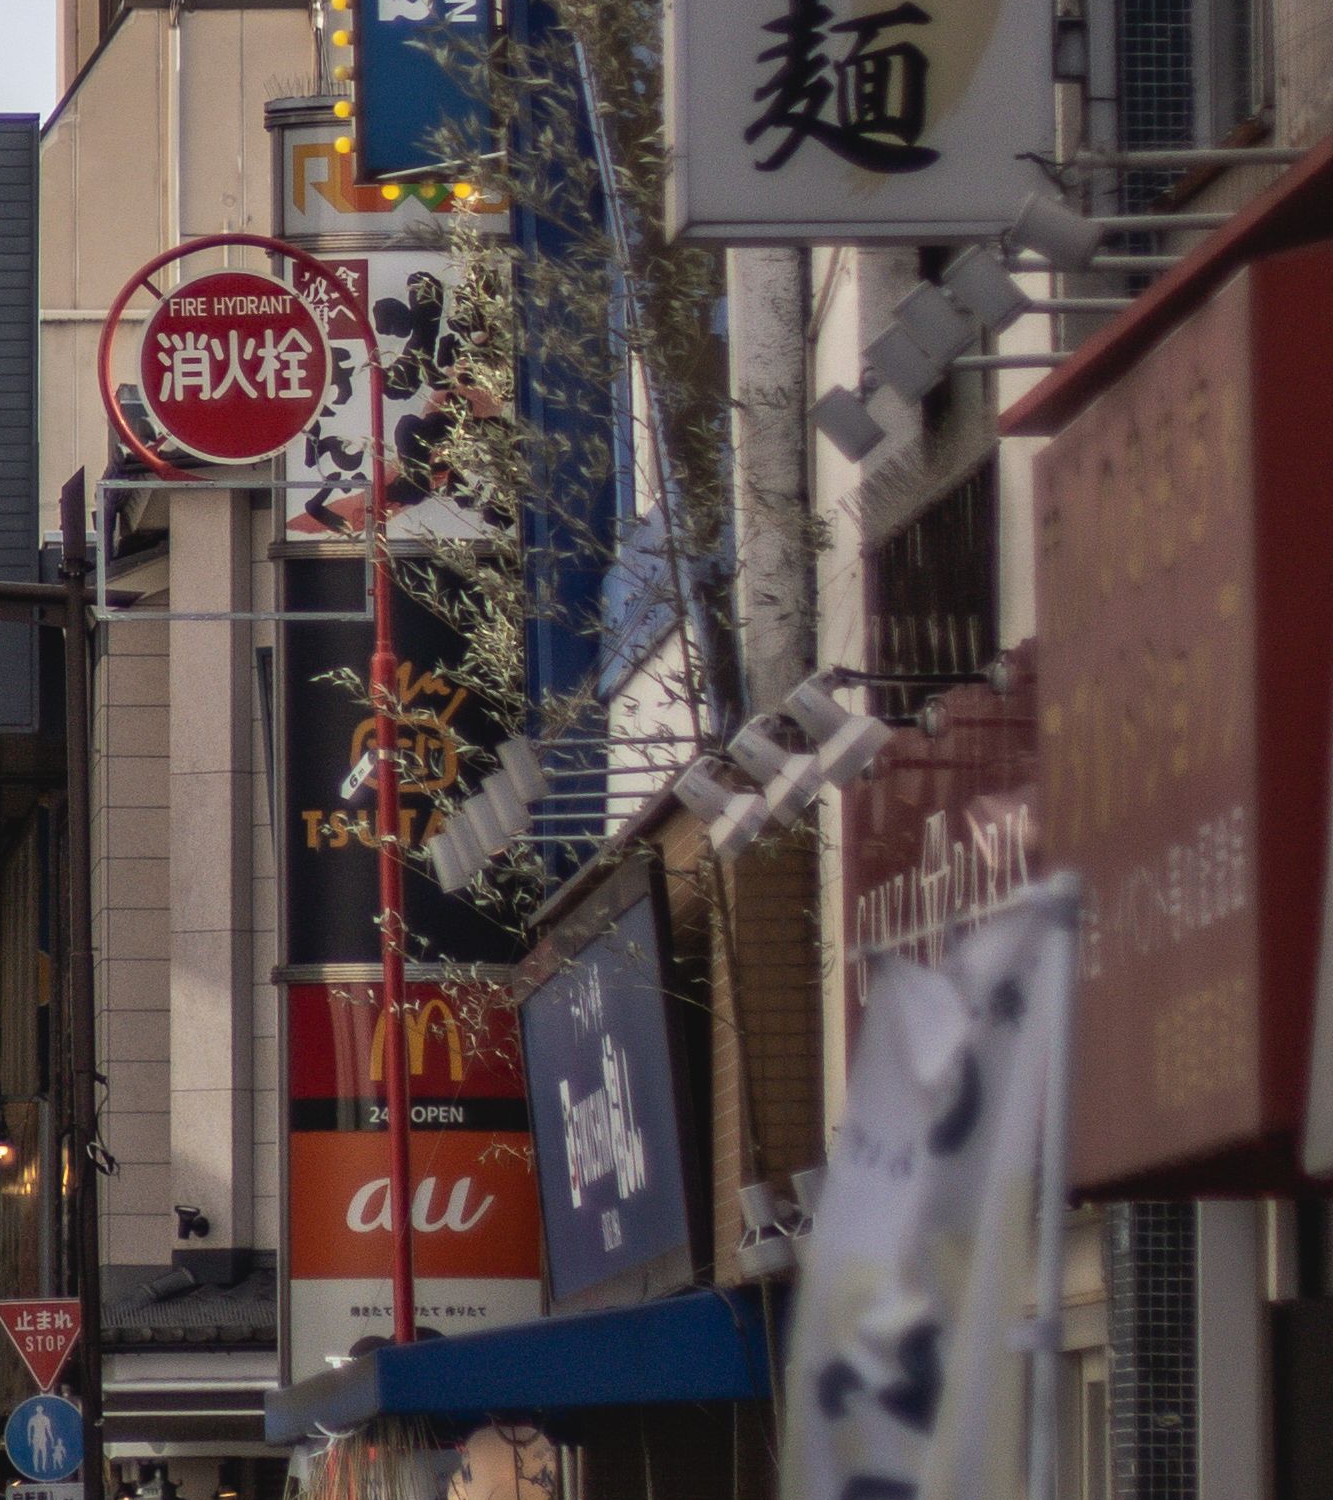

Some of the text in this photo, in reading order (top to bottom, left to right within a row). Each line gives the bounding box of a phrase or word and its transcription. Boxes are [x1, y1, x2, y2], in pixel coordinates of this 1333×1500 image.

[169, 295, 294, 317] FIRE HYDRANT
[157, 329, 313, 402] 消火栓
[410, 1106, 464, 1124] OPEN
[346, 1175, 495, 1234] au
[14, 1309, 74, 1333] 止まれ
[25, 1334, 66, 1352] STOP
